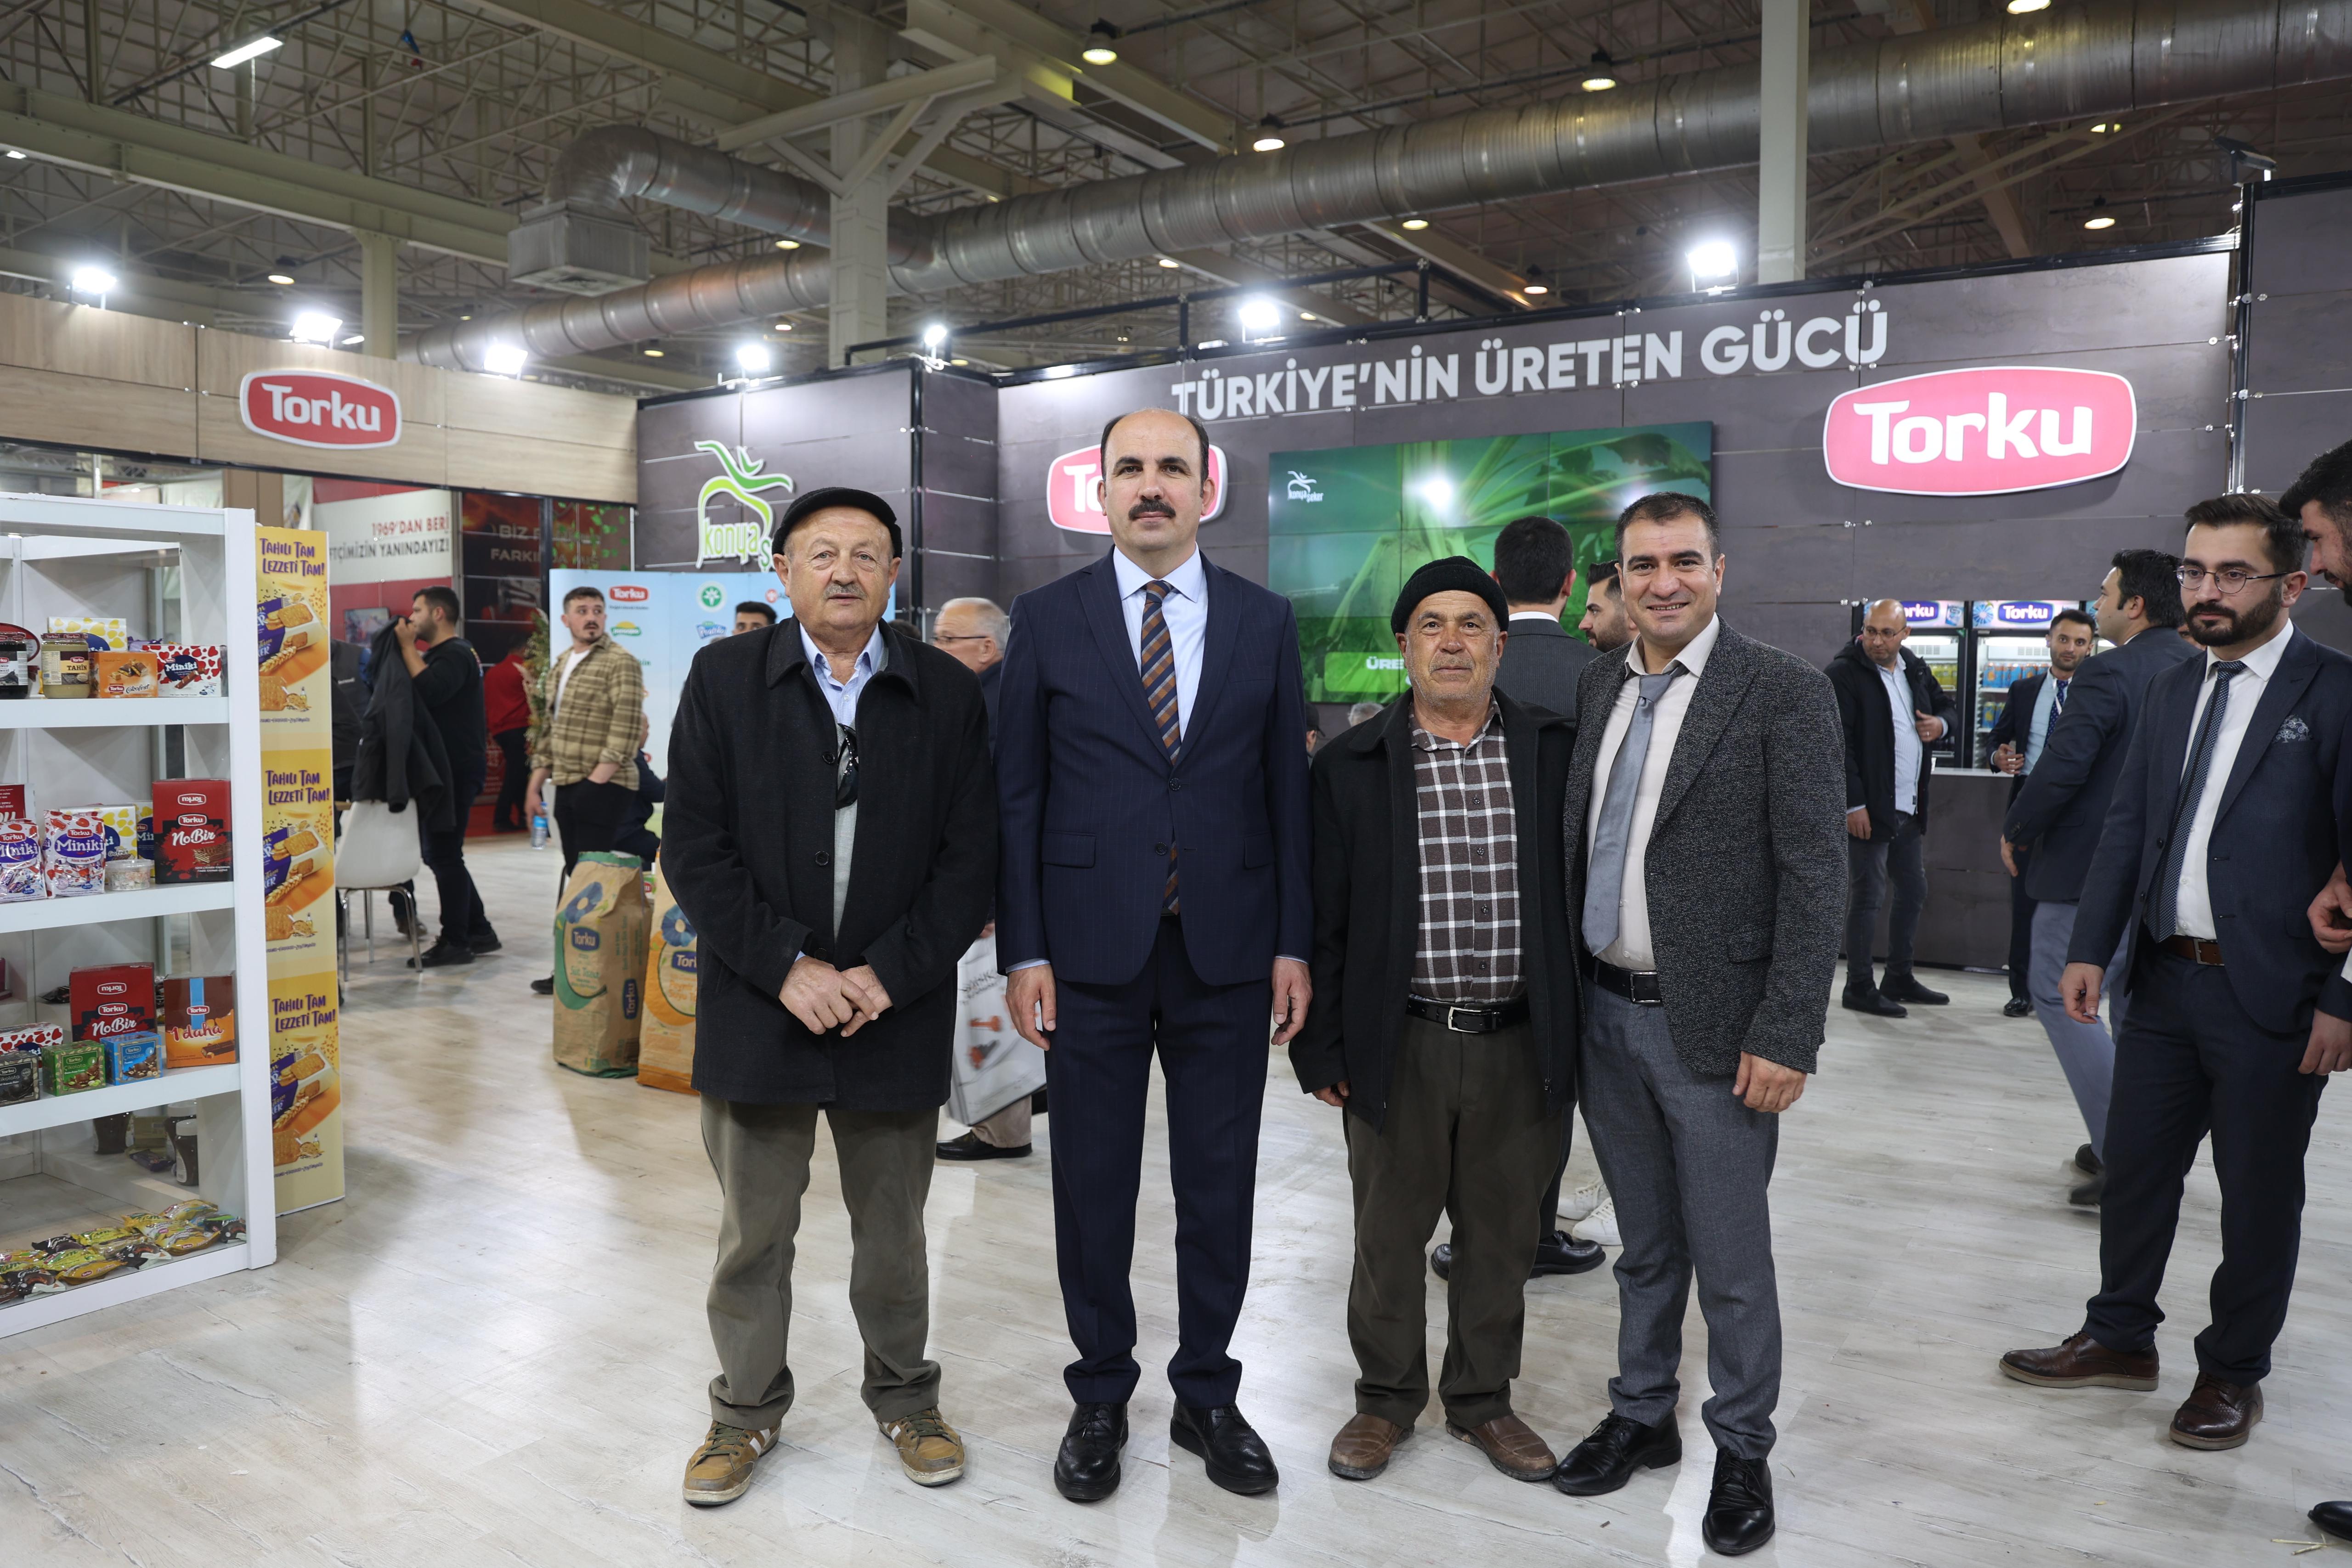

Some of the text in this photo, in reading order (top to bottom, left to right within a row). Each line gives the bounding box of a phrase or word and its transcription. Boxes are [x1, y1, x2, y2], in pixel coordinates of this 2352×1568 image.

[1171, 299, 1888, 421] TÜRKİYE'NİN ÜRETEN GÜCÜ
[261, 382, 381, 432] Torku
[1853, 392, 2093, 465] Torku
[1288, 490, 1307, 501] konya
[372, 512, 450, 536] 1969'DAN BERİ
[498, 523, 527, 540] BİZ
[294, 541, 315, 558] TAM
[704, 518, 760, 565] konya
[329, 540, 376, 564] FTÇİMİZİN
[263, 558, 325, 576] LEZZETİ TAM!
[612, 588, 645, 599] Torku
[2003, 604, 2048, 619] Torku
[165, 662, 198, 671] Miniki
[1366, 656, 1404, 670] ÜRE
[299, 770, 320, 786] TAM
[269, 787, 330, 805] LEZZETİ TAM!
[56, 839, 104, 852] Miniki
[573, 931, 596, 947] Torku
[676, 954, 697, 968] Tor
[305, 994, 326, 1010] TAM
[625, 983, 635, 1015] Torku
[275, 1009, 336, 1032] LEZZETİ TAM!
[182, 1022, 225, 1039] daha
